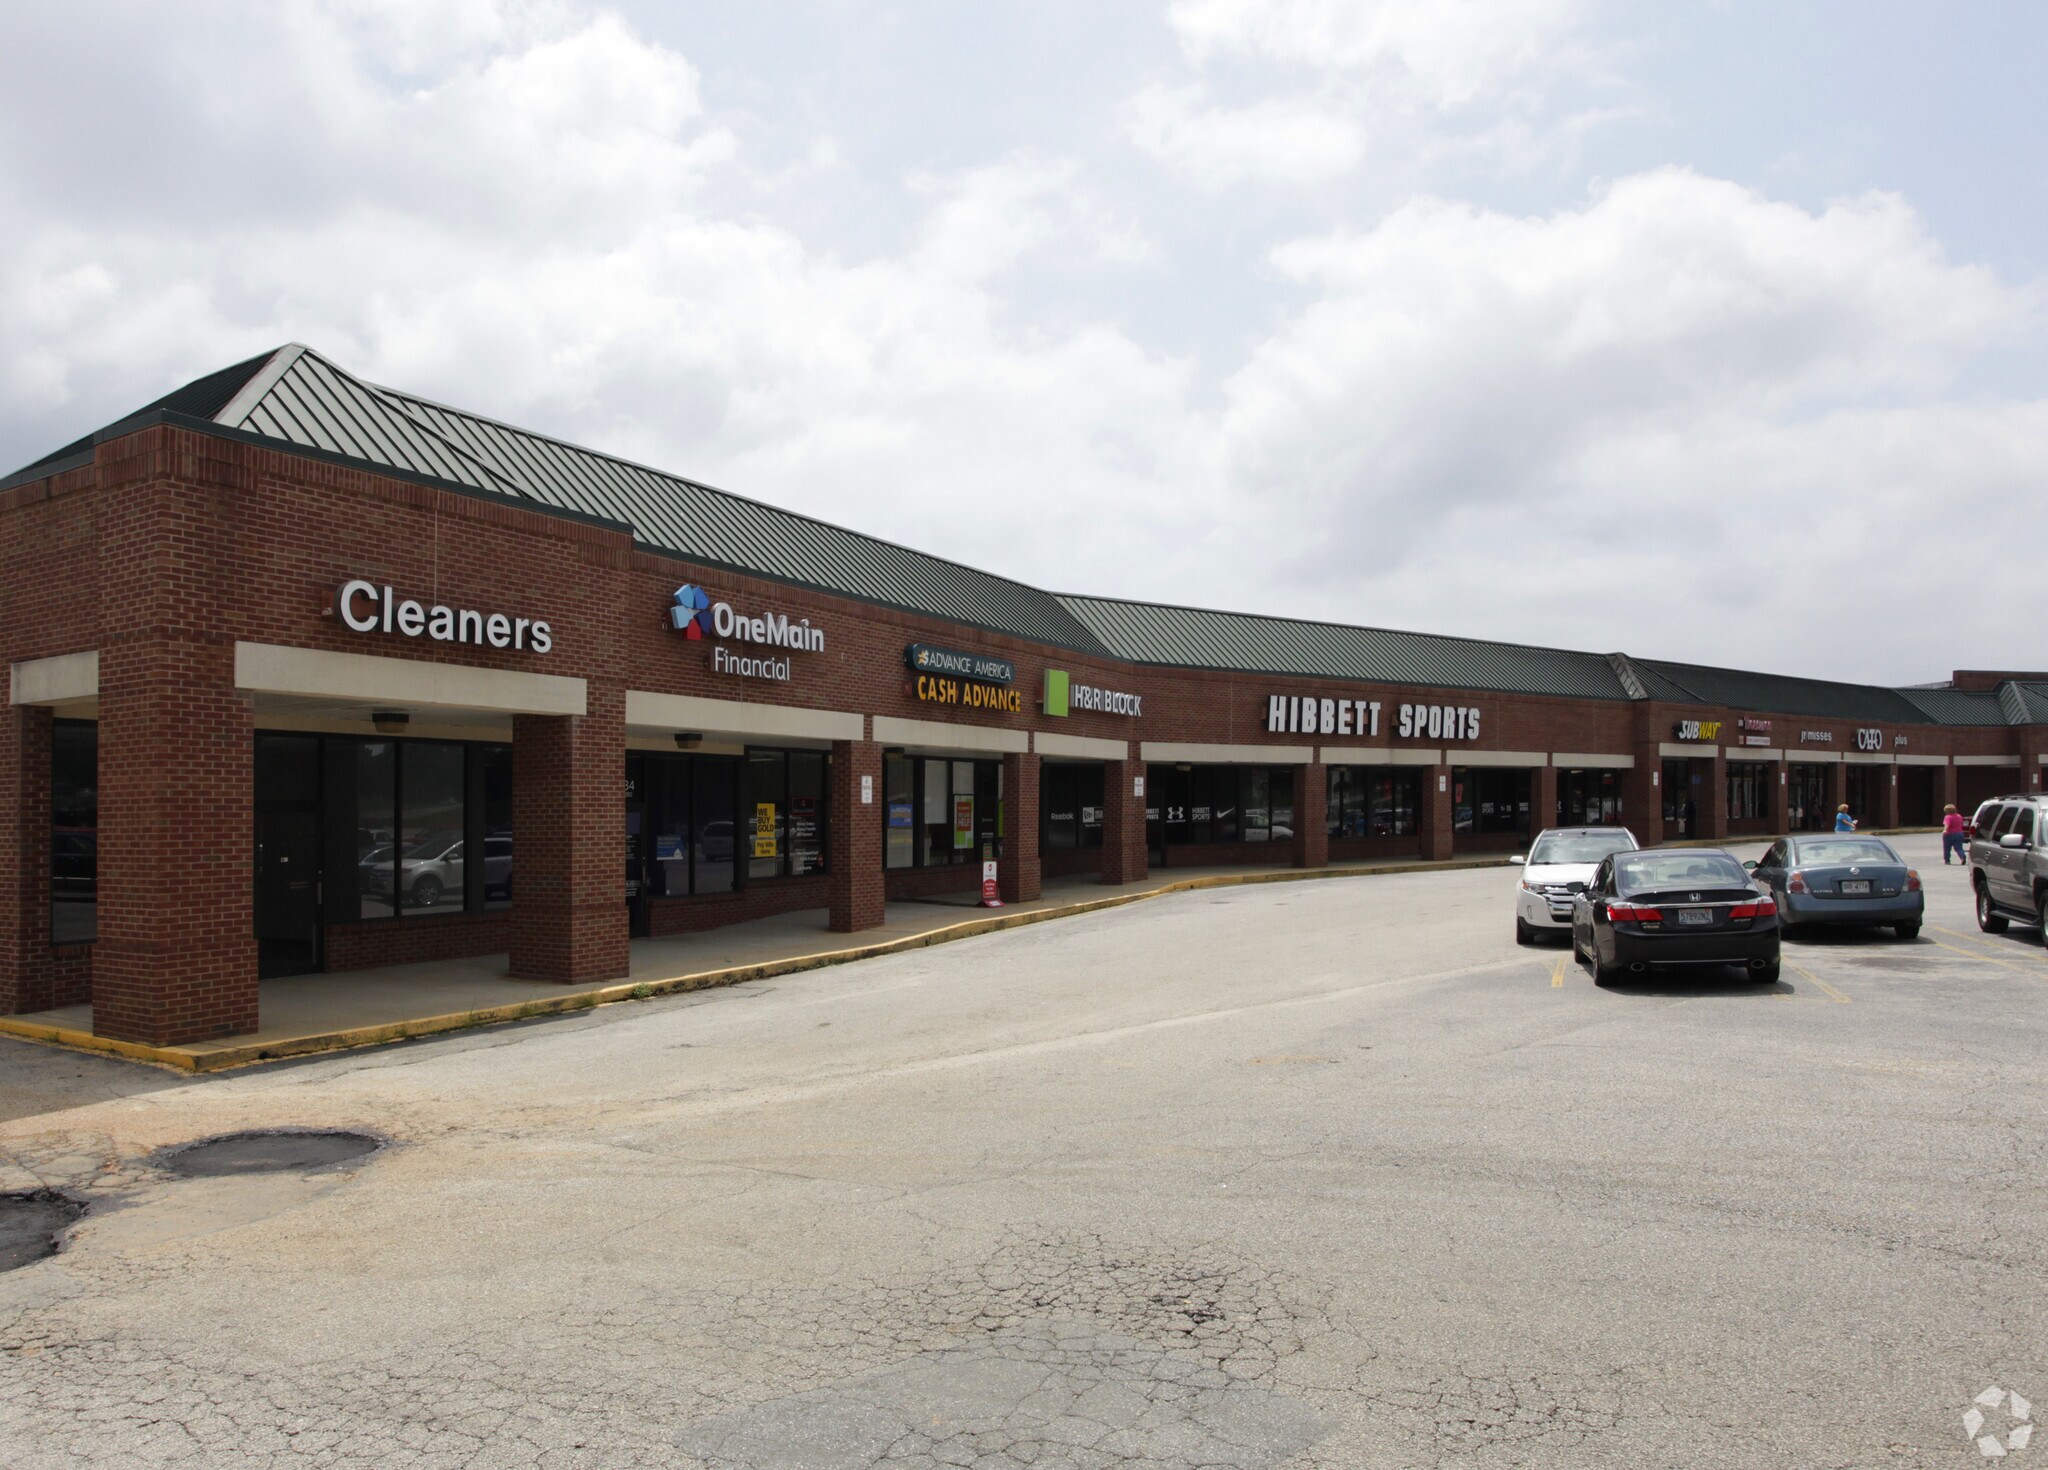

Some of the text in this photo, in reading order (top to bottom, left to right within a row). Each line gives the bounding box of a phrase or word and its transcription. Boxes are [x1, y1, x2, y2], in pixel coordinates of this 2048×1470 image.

[338, 579, 552, 653] Cleaners
[713, 602, 825, 652] OneMain
[714, 646, 790, 681] Financial
[929, 652, 1011, 680] ADVANCE AMERICA
[917, 676, 1021, 712] CASH ADVANCE
[1073, 684, 1142, 717] H&R BLOCK
[1268, 695, 1480, 740] HIBBETT SPORTS
[1679, 720, 1721, 739] SUBWAY
[1857, 728, 1882, 750] CATO
[1894, 734, 1908, 747] plus
[757, 808, 768, 816] WE
[757, 816, 771, 824] BUY
[1051, 812, 1074, 820] Reebok
[757, 824, 775, 832] GOLD
